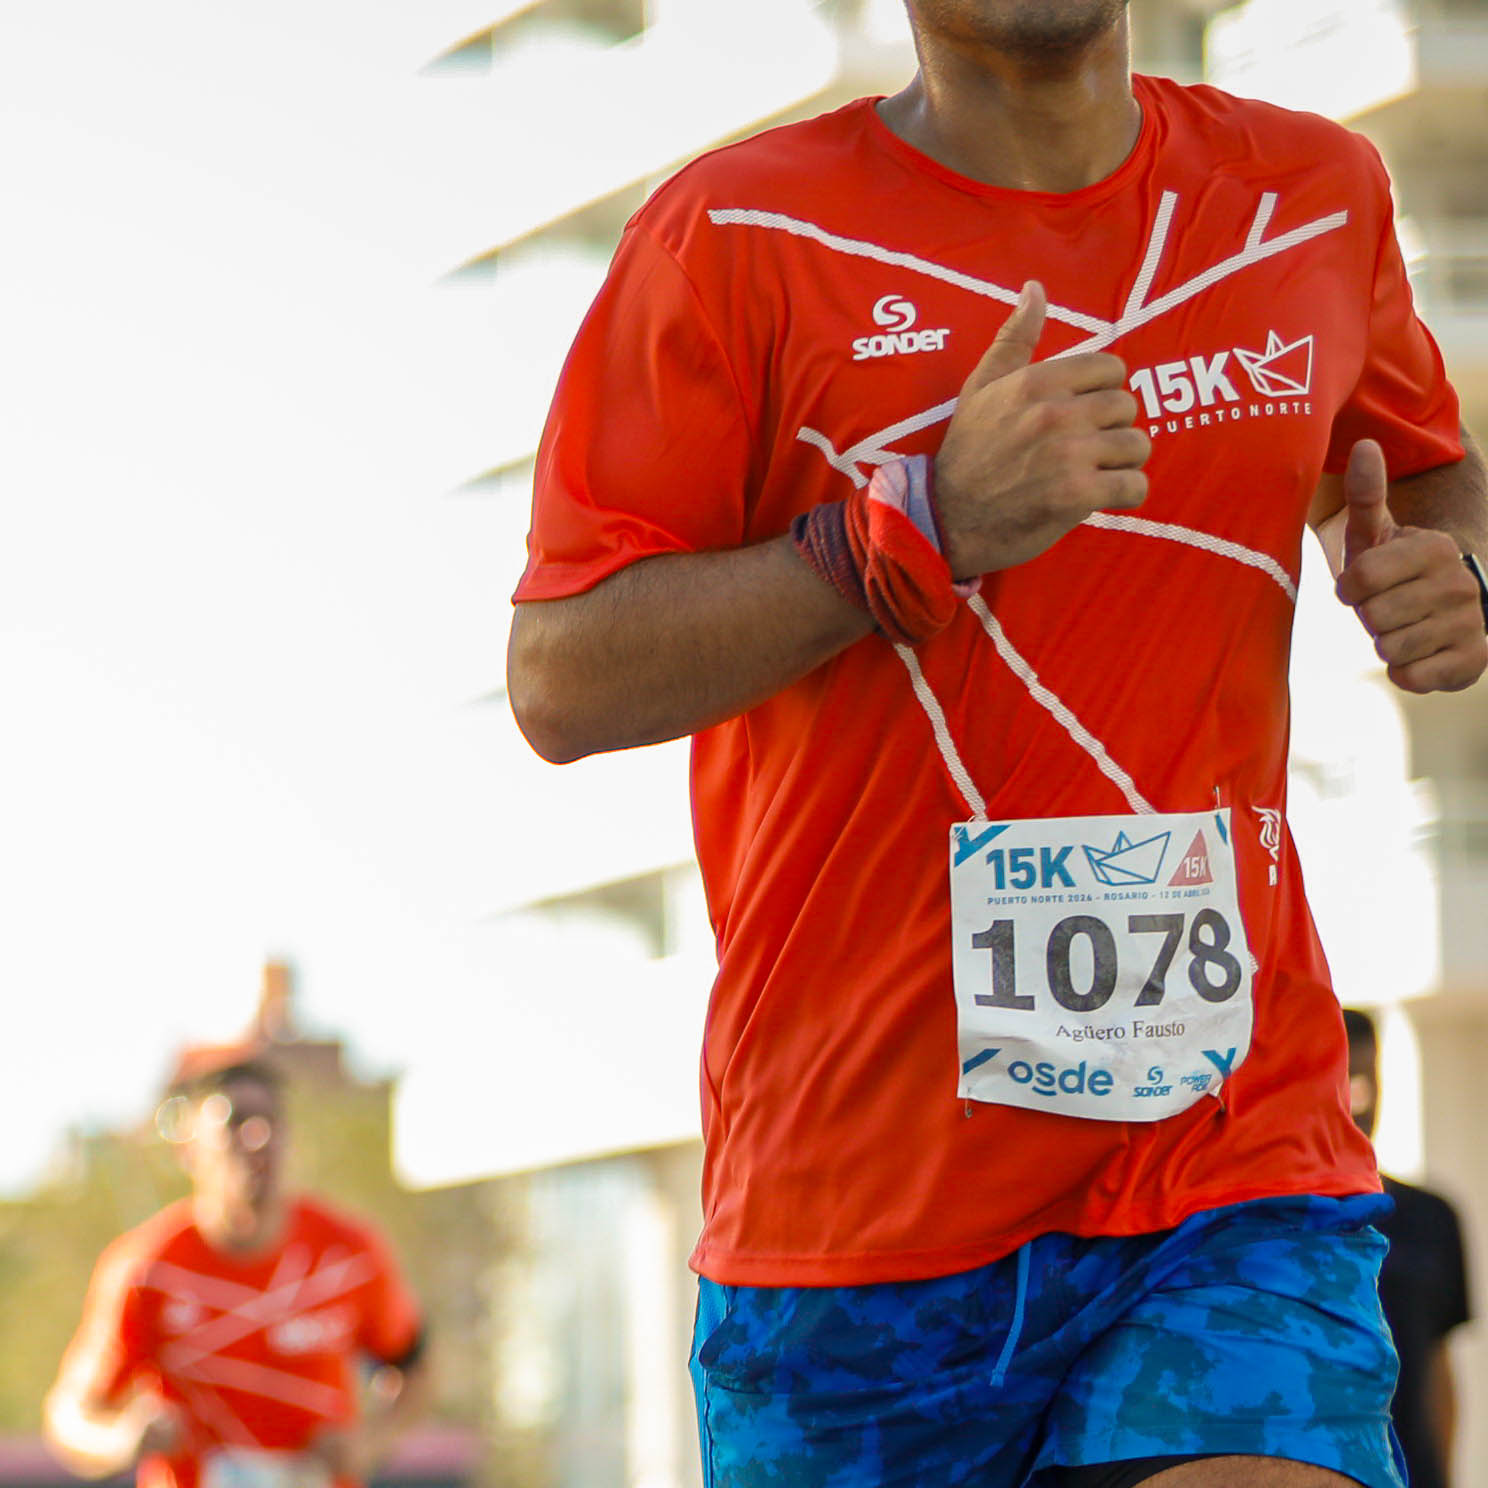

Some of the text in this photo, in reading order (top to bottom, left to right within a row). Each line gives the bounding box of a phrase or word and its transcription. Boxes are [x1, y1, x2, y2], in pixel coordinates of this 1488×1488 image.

[1129, 351, 1240, 419] 15K
[1149, 402, 1312, 438] PUERTO NORTE
[986, 845, 1076, 890] 15K
[987, 894, 1027, 905] PUERTO
[1031, 894, 1064, 904] NORTE
[1068, 893, 1092, 903] 2026
[1104, 891, 1148, 901] ROSARIO
[1160, 890, 1169, 899] 12
[972, 908, 1242, 1012] 1078
[1056, 1020, 1185, 1042] Agüero Fausto
[1008, 1060, 1114, 1096] osde
